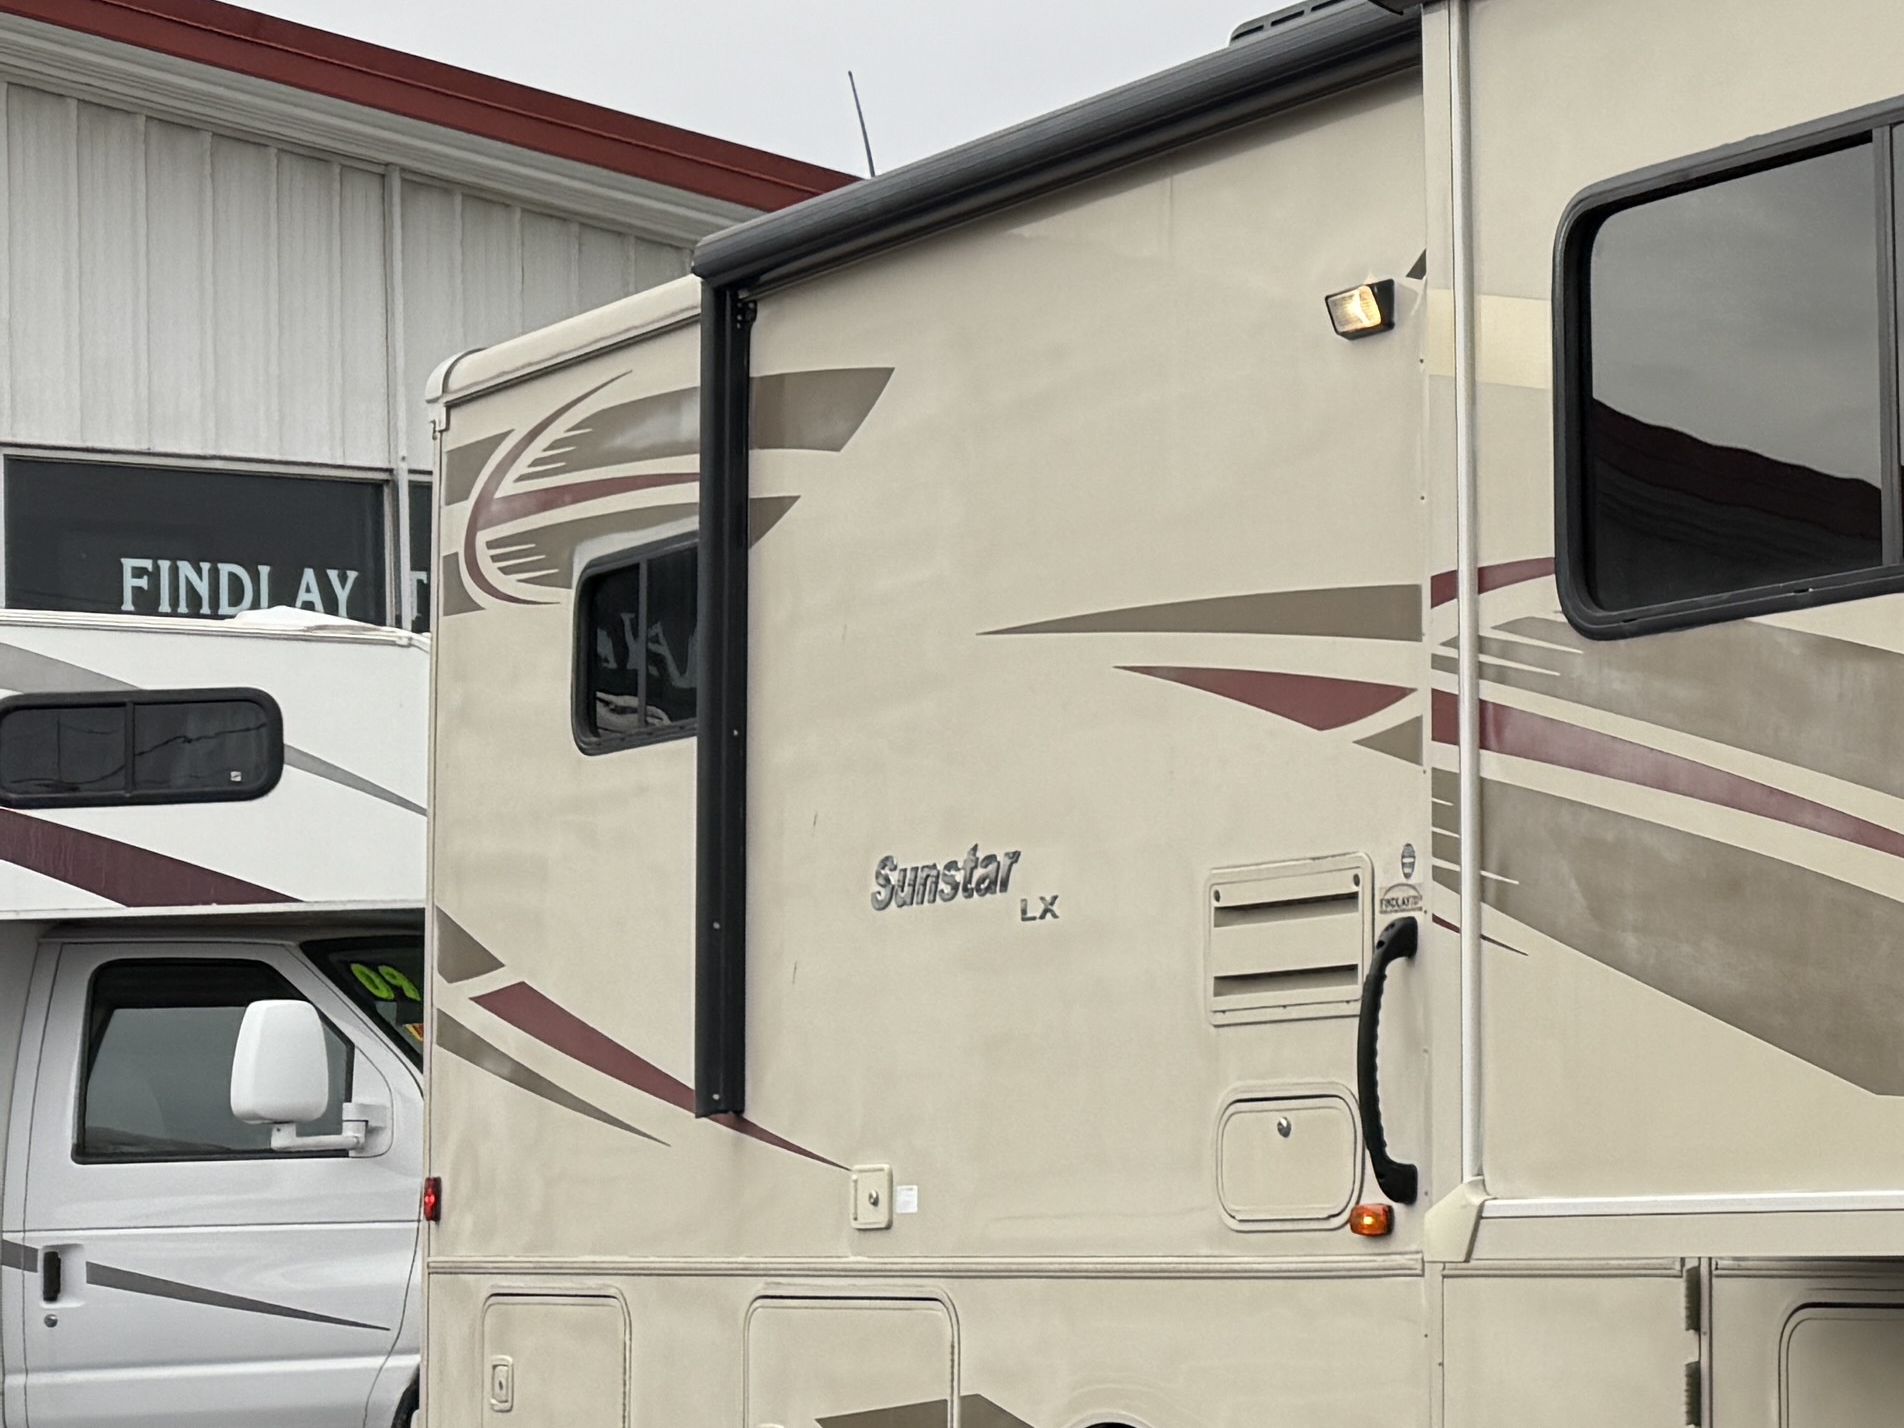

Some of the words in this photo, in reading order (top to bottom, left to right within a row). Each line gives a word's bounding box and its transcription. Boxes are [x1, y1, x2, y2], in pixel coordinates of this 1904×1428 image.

[120, 557, 359, 617] FINDLAY
[870, 842, 1022, 912] Sunstar
[1020, 894, 1060, 922] LX
[351, 963, 422, 1002] 09
